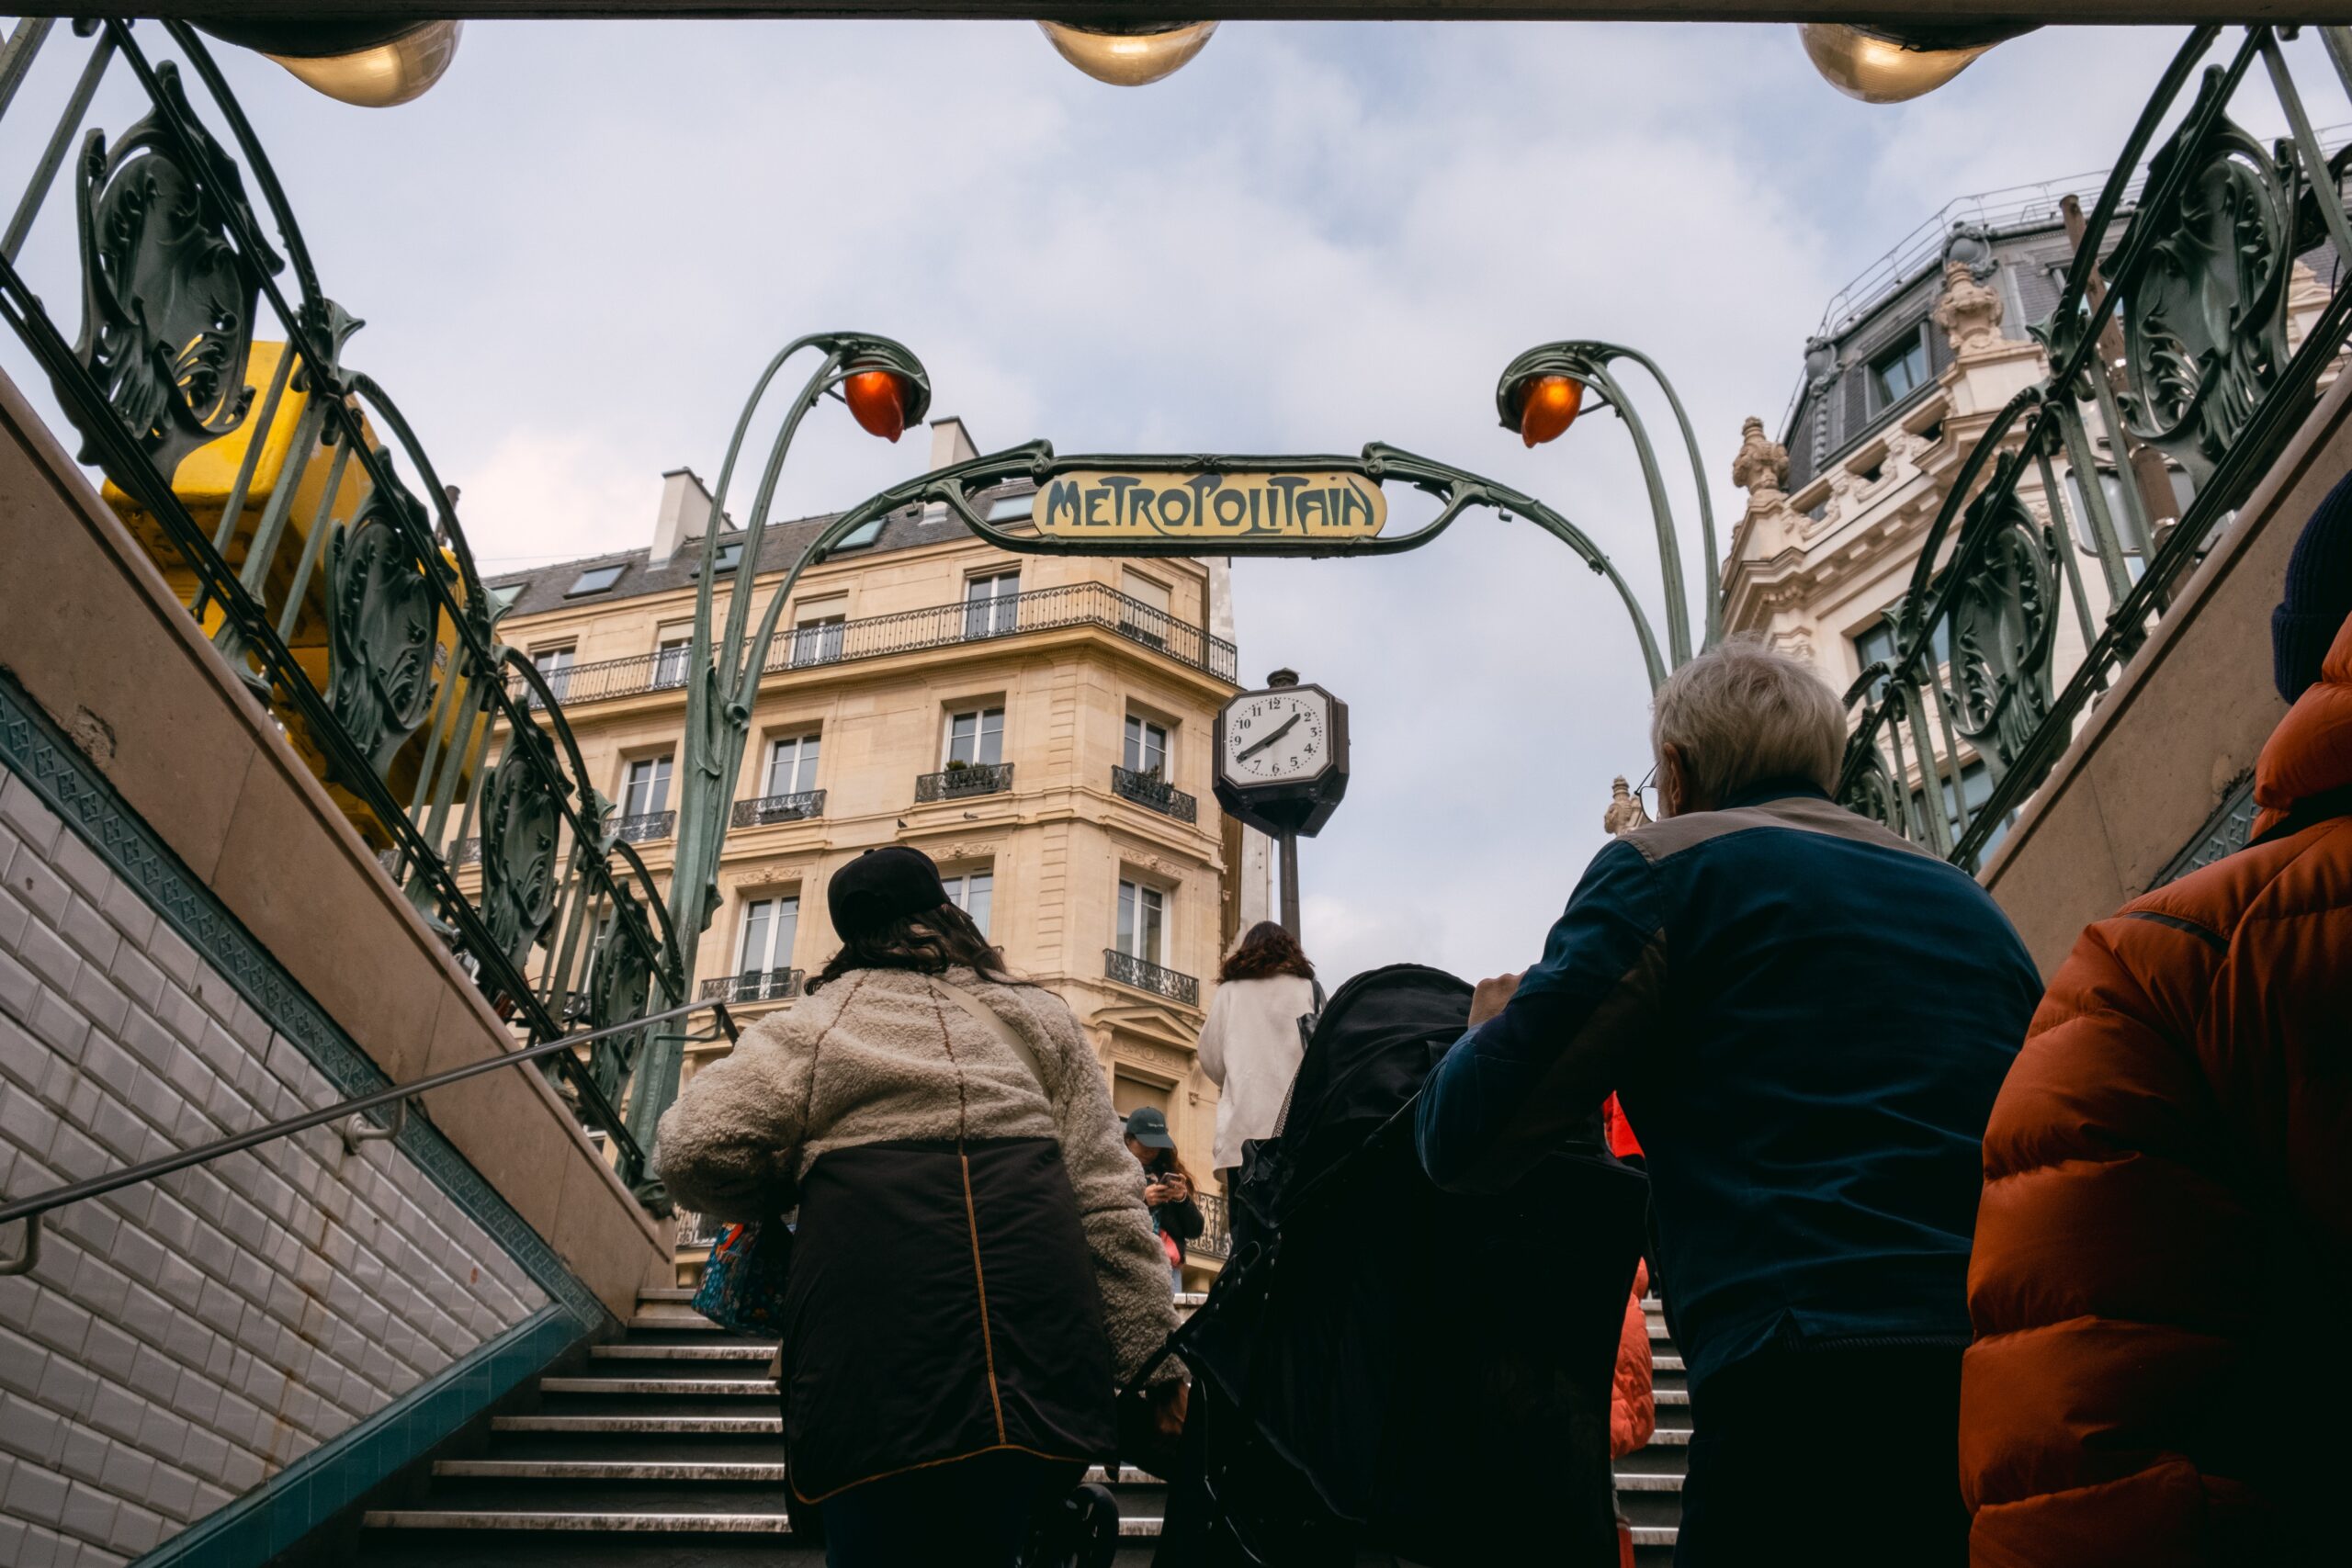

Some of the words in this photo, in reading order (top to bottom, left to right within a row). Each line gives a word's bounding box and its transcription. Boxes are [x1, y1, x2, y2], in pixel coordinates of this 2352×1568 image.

[1046, 475, 1374, 535] METROPOLITAIN
[1269, 699, 1281, 709] 12
[1292, 704, 1296, 712] 1
[1252, 707, 1261, 716] 11
[1305, 712, 1311, 721] 2
[1238, 719, 1251, 728] 10
[1310, 728, 1317, 738] 3
[1234, 736, 1241, 745] 9
[1304, 743, 1313, 753] 4
[1254, 760, 1261, 770] 7
[1291, 757, 1297, 767] 5
[1272, 763, 1280, 773] 6
